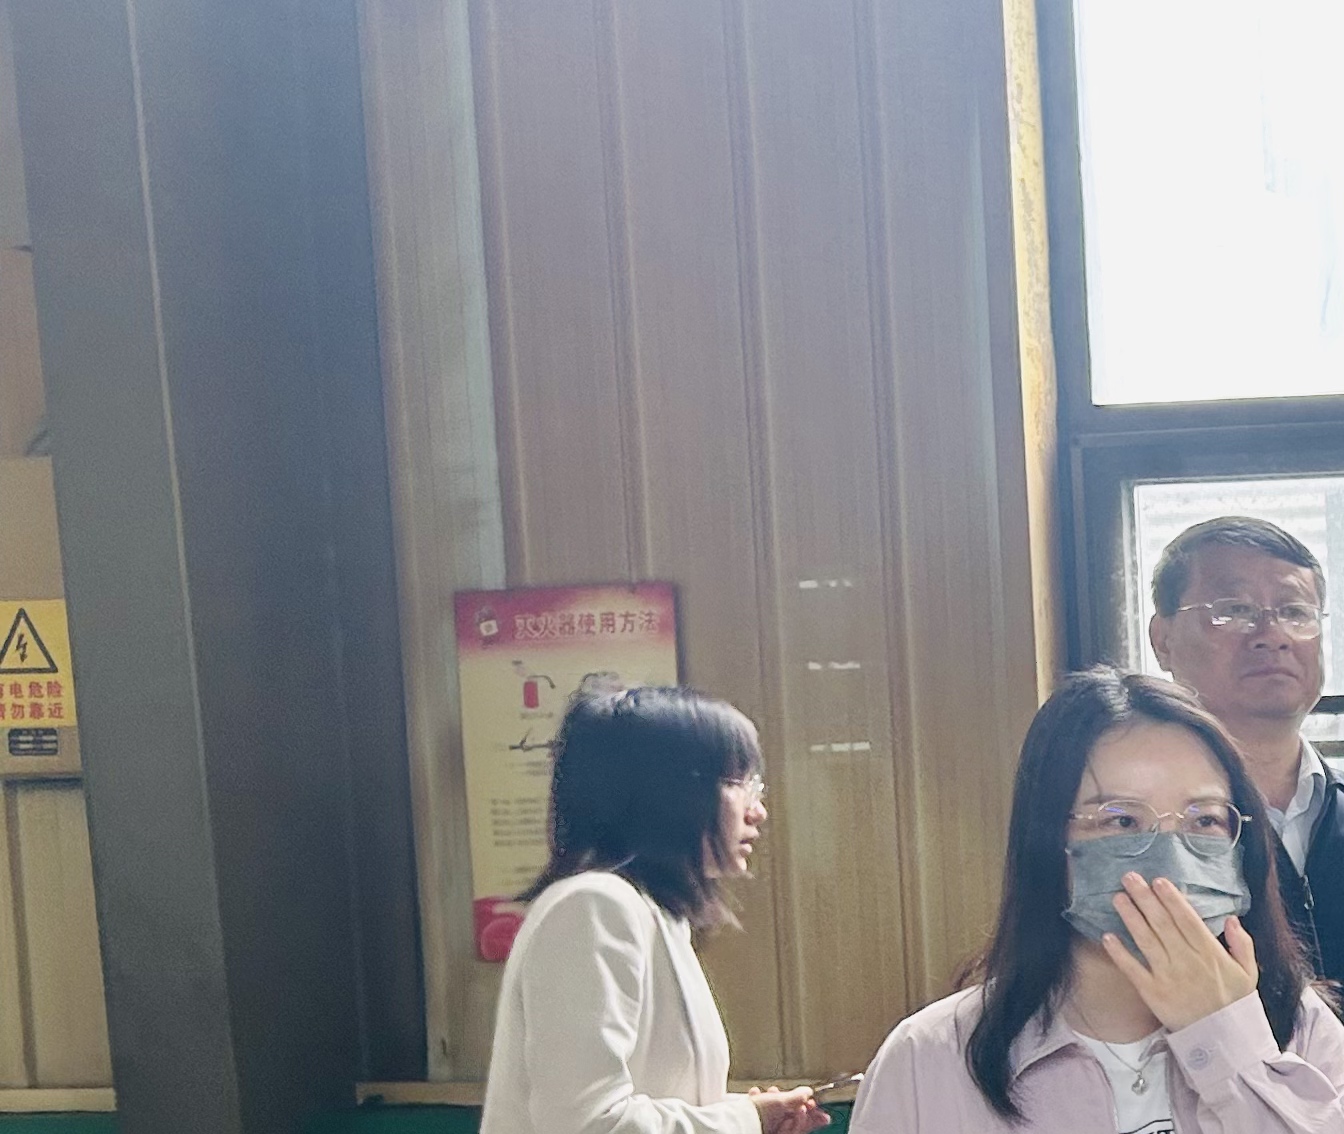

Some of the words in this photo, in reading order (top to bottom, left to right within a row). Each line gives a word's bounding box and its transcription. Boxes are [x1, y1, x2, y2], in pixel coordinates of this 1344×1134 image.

[515, 610, 659, 639] 灭火器使用方法
[0, 681, 63, 699] 电危险
